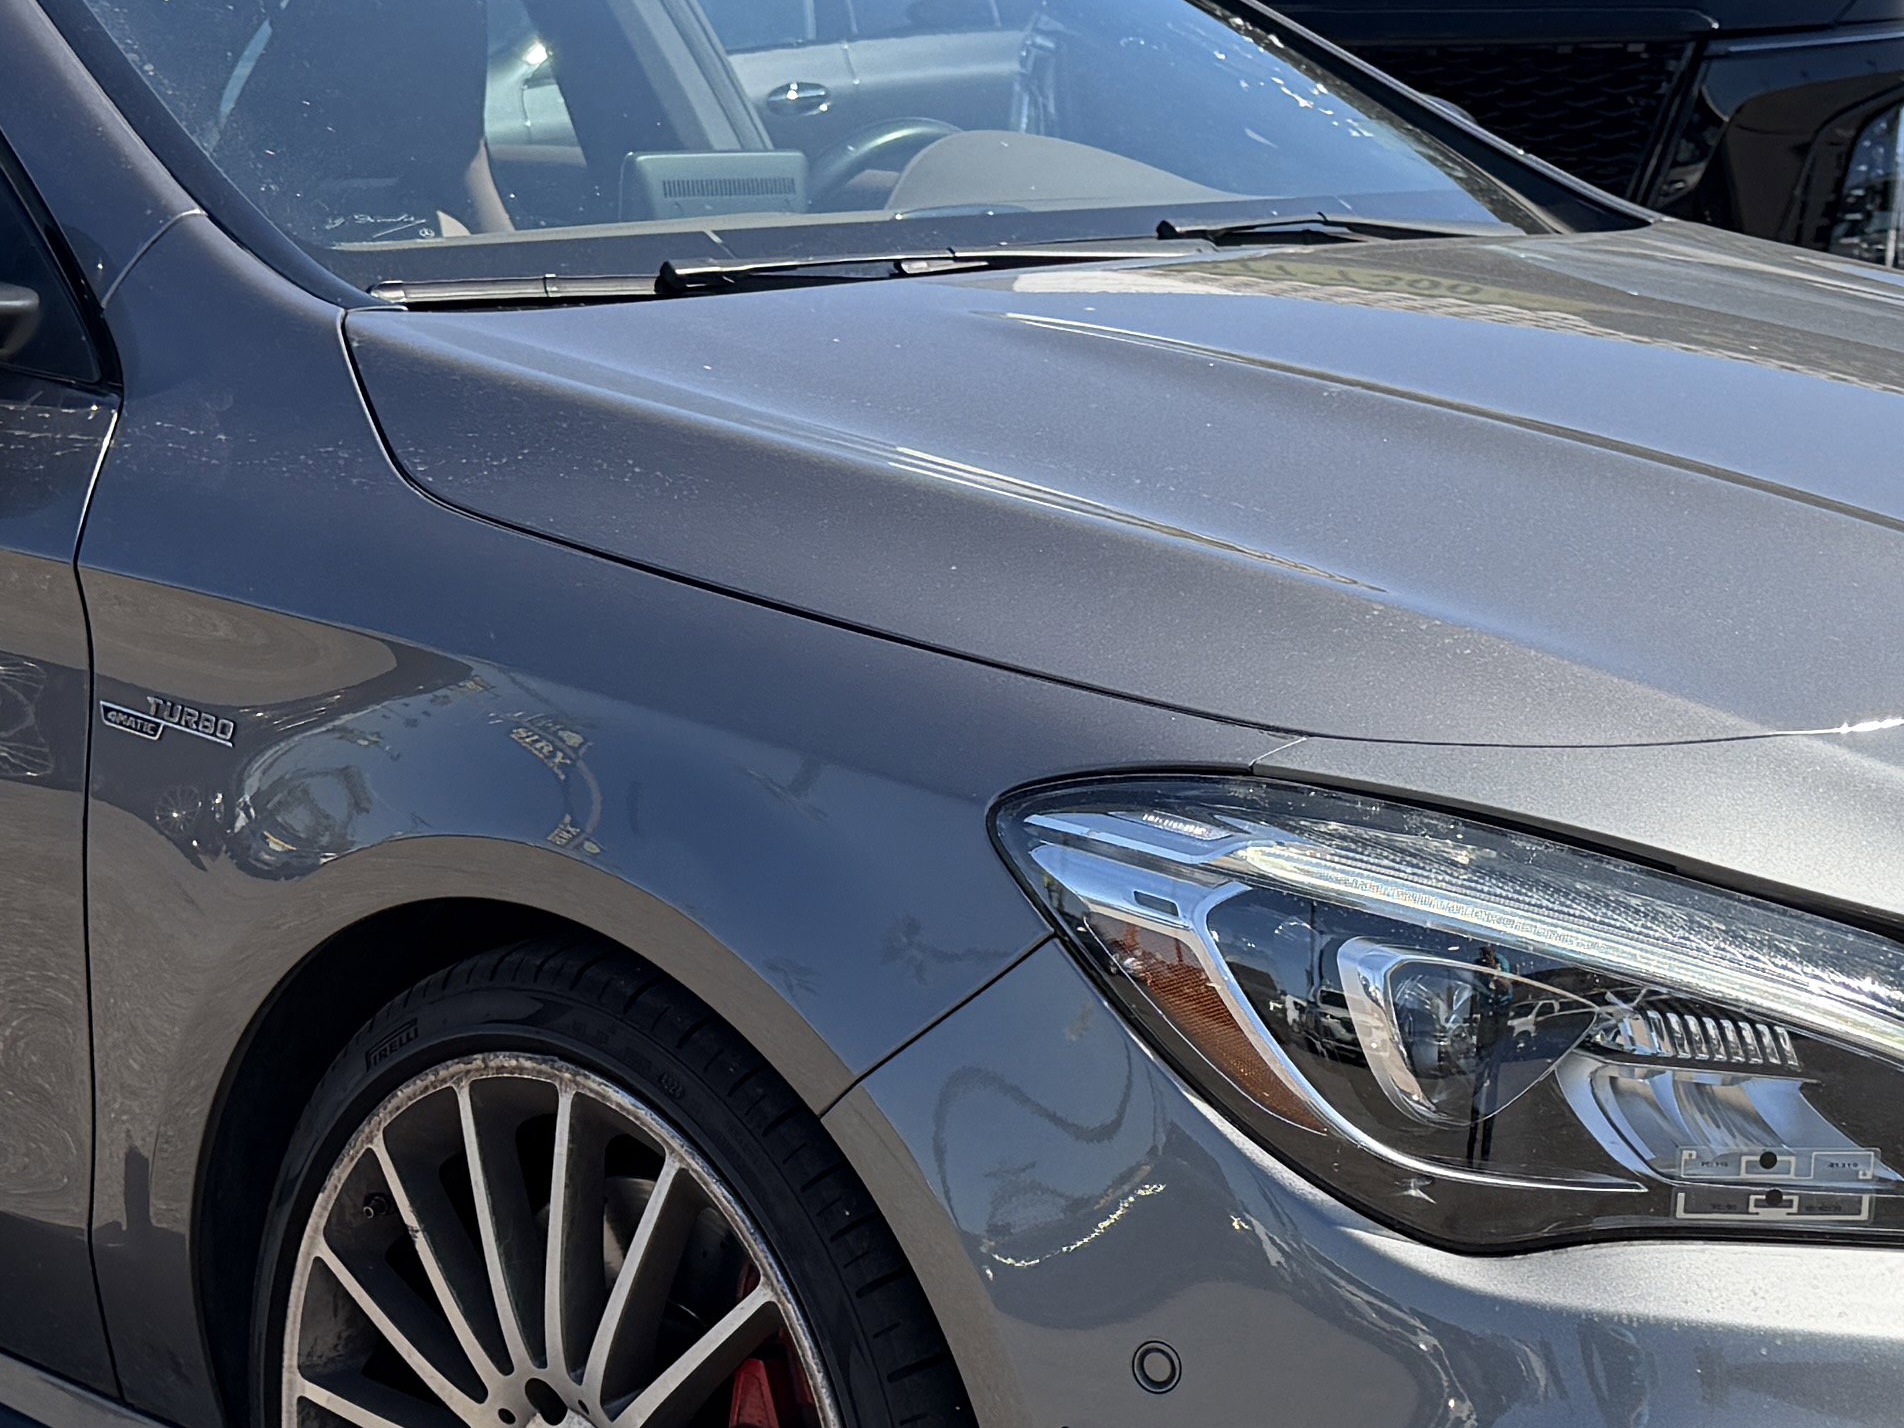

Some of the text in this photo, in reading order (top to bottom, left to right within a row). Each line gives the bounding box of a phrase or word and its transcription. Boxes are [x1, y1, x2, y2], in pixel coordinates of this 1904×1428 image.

[107, 710, 157, 734] 4MATIC
[147, 696, 234, 740] TURBO
[365, 1018, 419, 1072] PIRELLI
